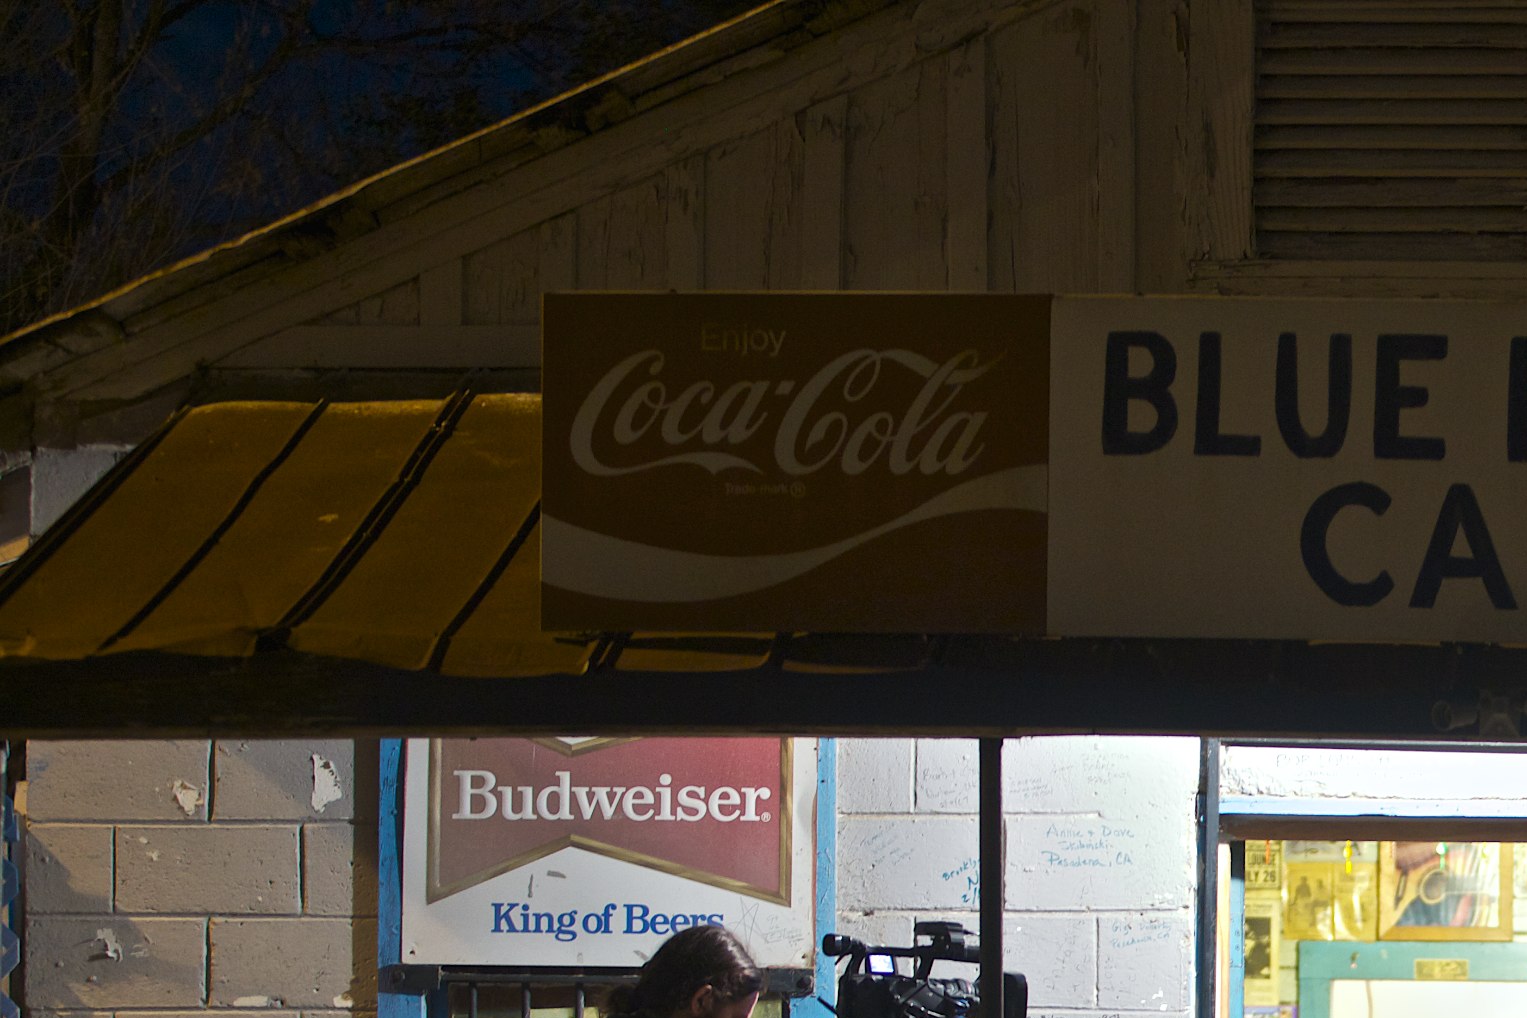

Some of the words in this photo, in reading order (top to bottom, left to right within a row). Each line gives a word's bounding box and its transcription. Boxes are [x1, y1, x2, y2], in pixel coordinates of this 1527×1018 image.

[700, 325, 787, 357] Enjoy
[569, 348, 1008, 477] Coca-Cola
[1102, 331, 1448, 460] BLUE
[452, 770, 771, 822] Budweiser
[1116, 851, 1133, 865] CA
[491, 903, 577, 942] King
[582, 904, 617, 936] of
